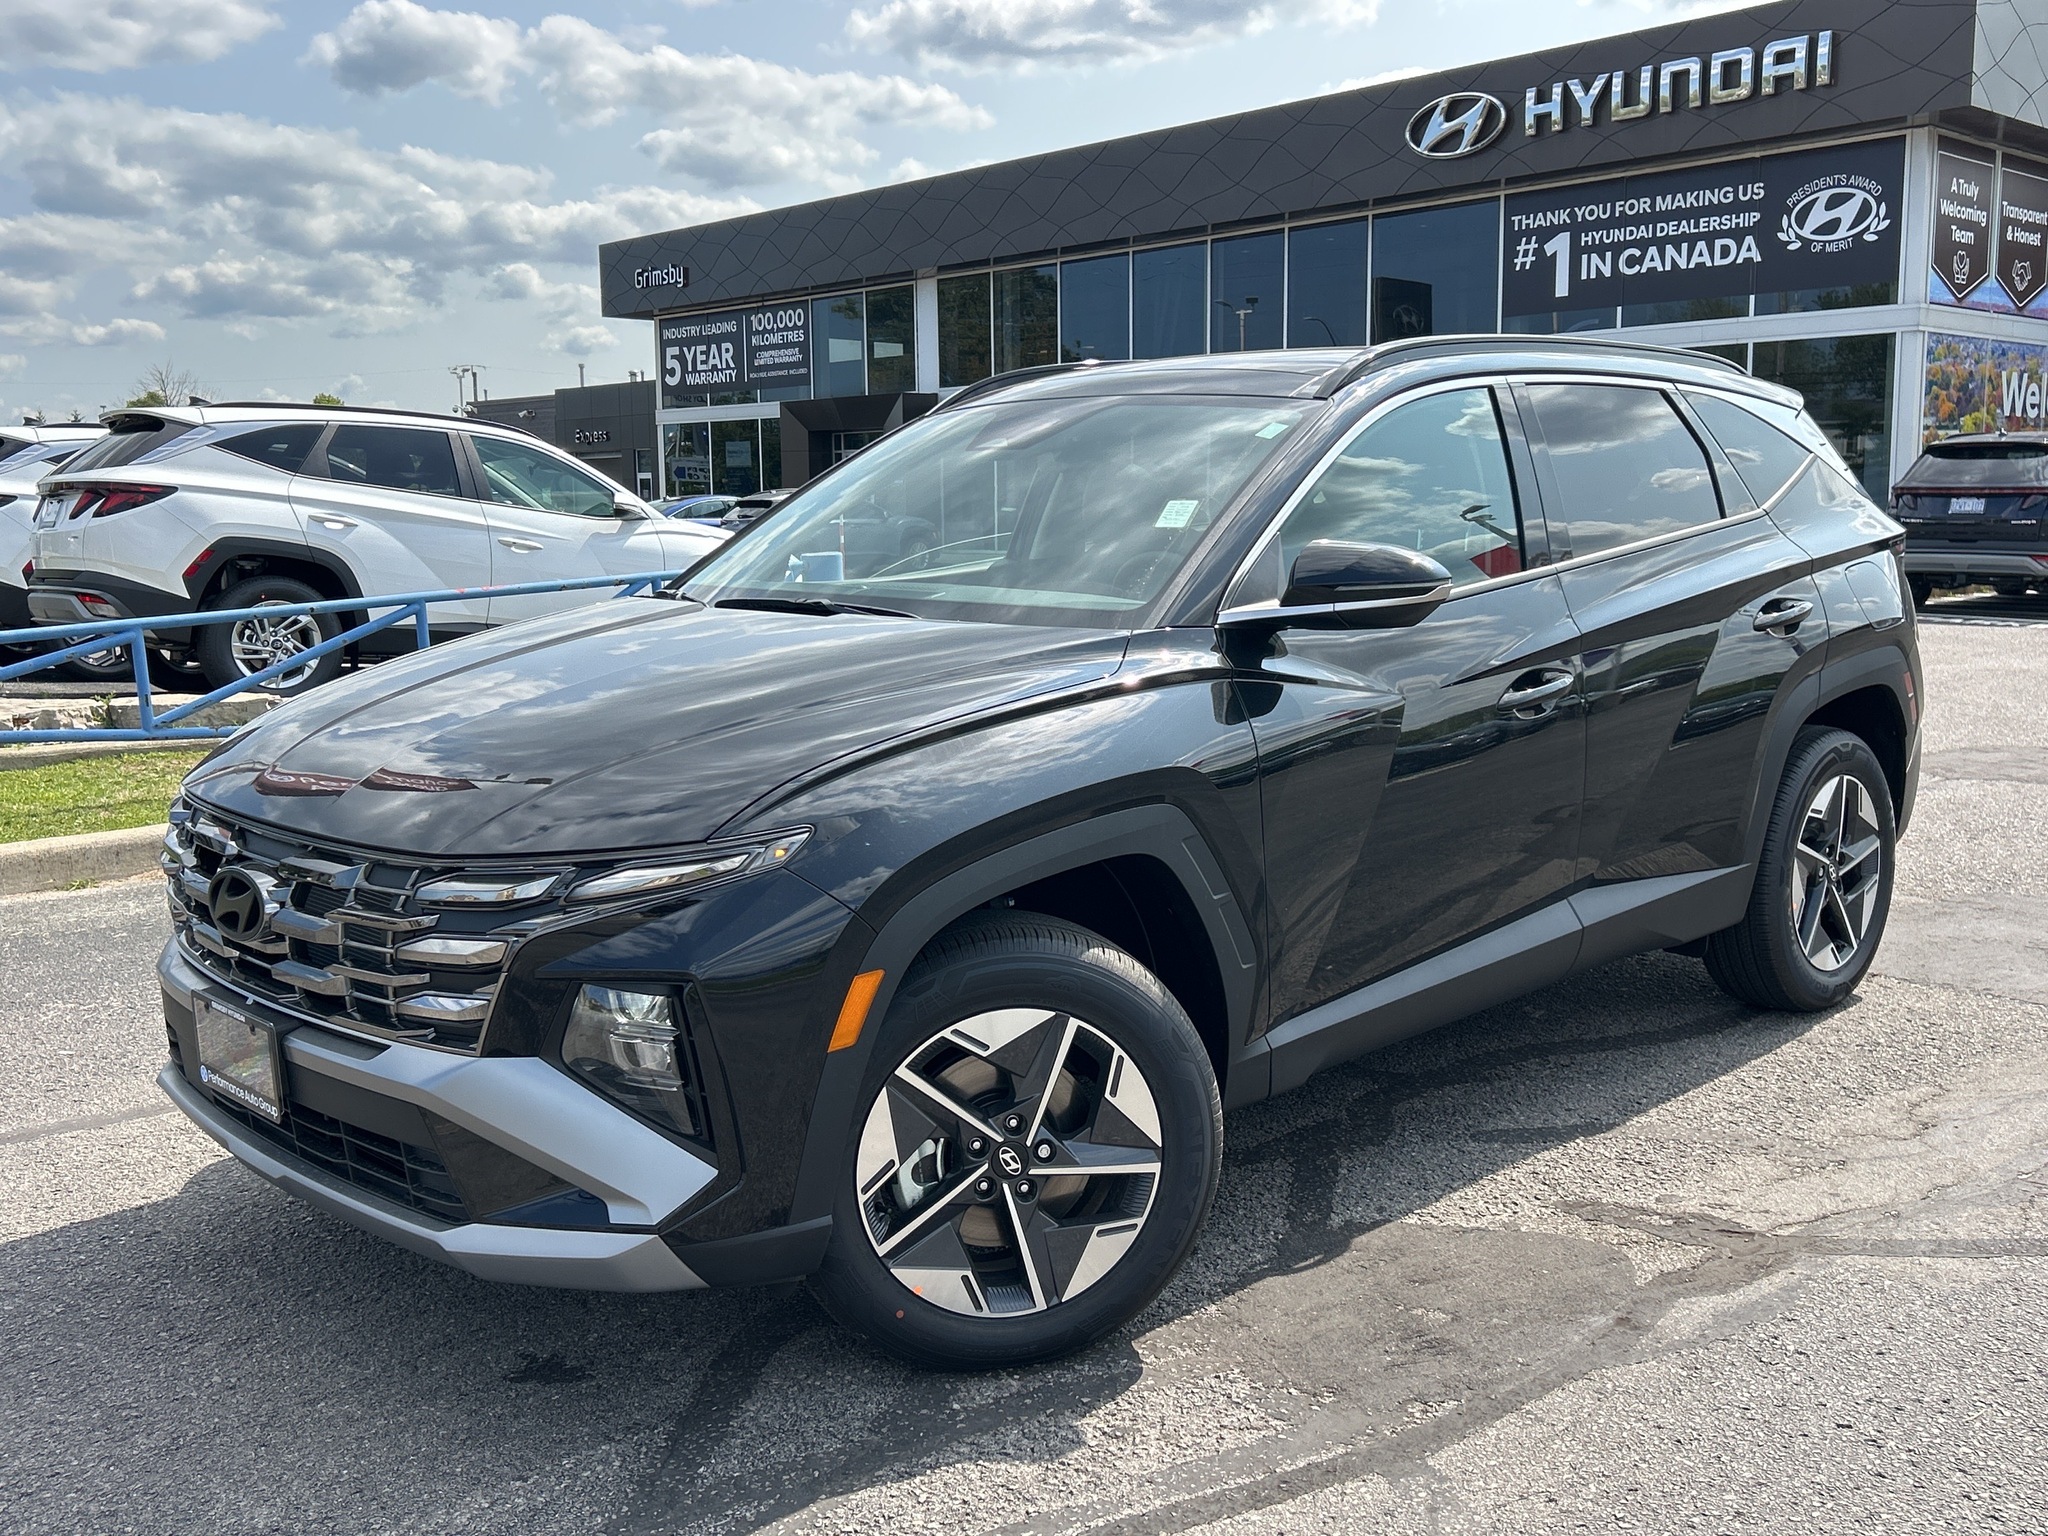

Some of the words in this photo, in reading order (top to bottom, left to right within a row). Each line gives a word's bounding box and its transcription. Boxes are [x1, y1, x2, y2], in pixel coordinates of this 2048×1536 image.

[1525, 30, 1833, 136] HYUNDAI
[1786, 174, 1847, 208] PRESIDENT'S
[1848, 174, 1882, 197] AWARD
[1950, 177, 1958, 194] A
[1959, 179, 1979, 202] Truly
[1511, 208, 1572, 231] THANK
[1574, 203, 1611, 222] YOU
[1615, 200, 1651, 217] FOR
[1655, 186, 1734, 212] MAKING
[1738, 182, 1765, 201] US
[1940, 198, 1987, 228] Welcoming
[2002, 201, 2048, 226] Transparent
[1581, 223, 1653, 247] HYUNDAI
[1656, 212, 1761, 238] DEALERSHIP
[1951, 225, 1974, 245] Team
[2006, 225, 2013, 242] &
[2014, 226, 2041, 247] Honest
[1810, 241, 1823, 253] OF
[1825, 237, 1853, 253] MERIT
[1581, 251, 1612, 281] IN
[1618, 235, 1762, 275] CANADA
[634, 263, 685, 289] Grimsby
[663, 325, 701, 340] INDUSTRY
[702, 320, 737, 336] LEADING
[750, 308, 805, 332] 100,000
[751, 330, 805, 347] KILOMETRES
[665, 346, 682, 387] 5
[682, 342, 736, 372] YEAR
[774, 354, 803, 364] WARRANTY
[685, 369, 737, 386] WARRANTY
[2002, 370, 2048, 419] Wel
[207, 1069, 245, 1099] Performance
[244, 1090, 259, 1107] Auto
[259, 1097, 278, 1119] Group
